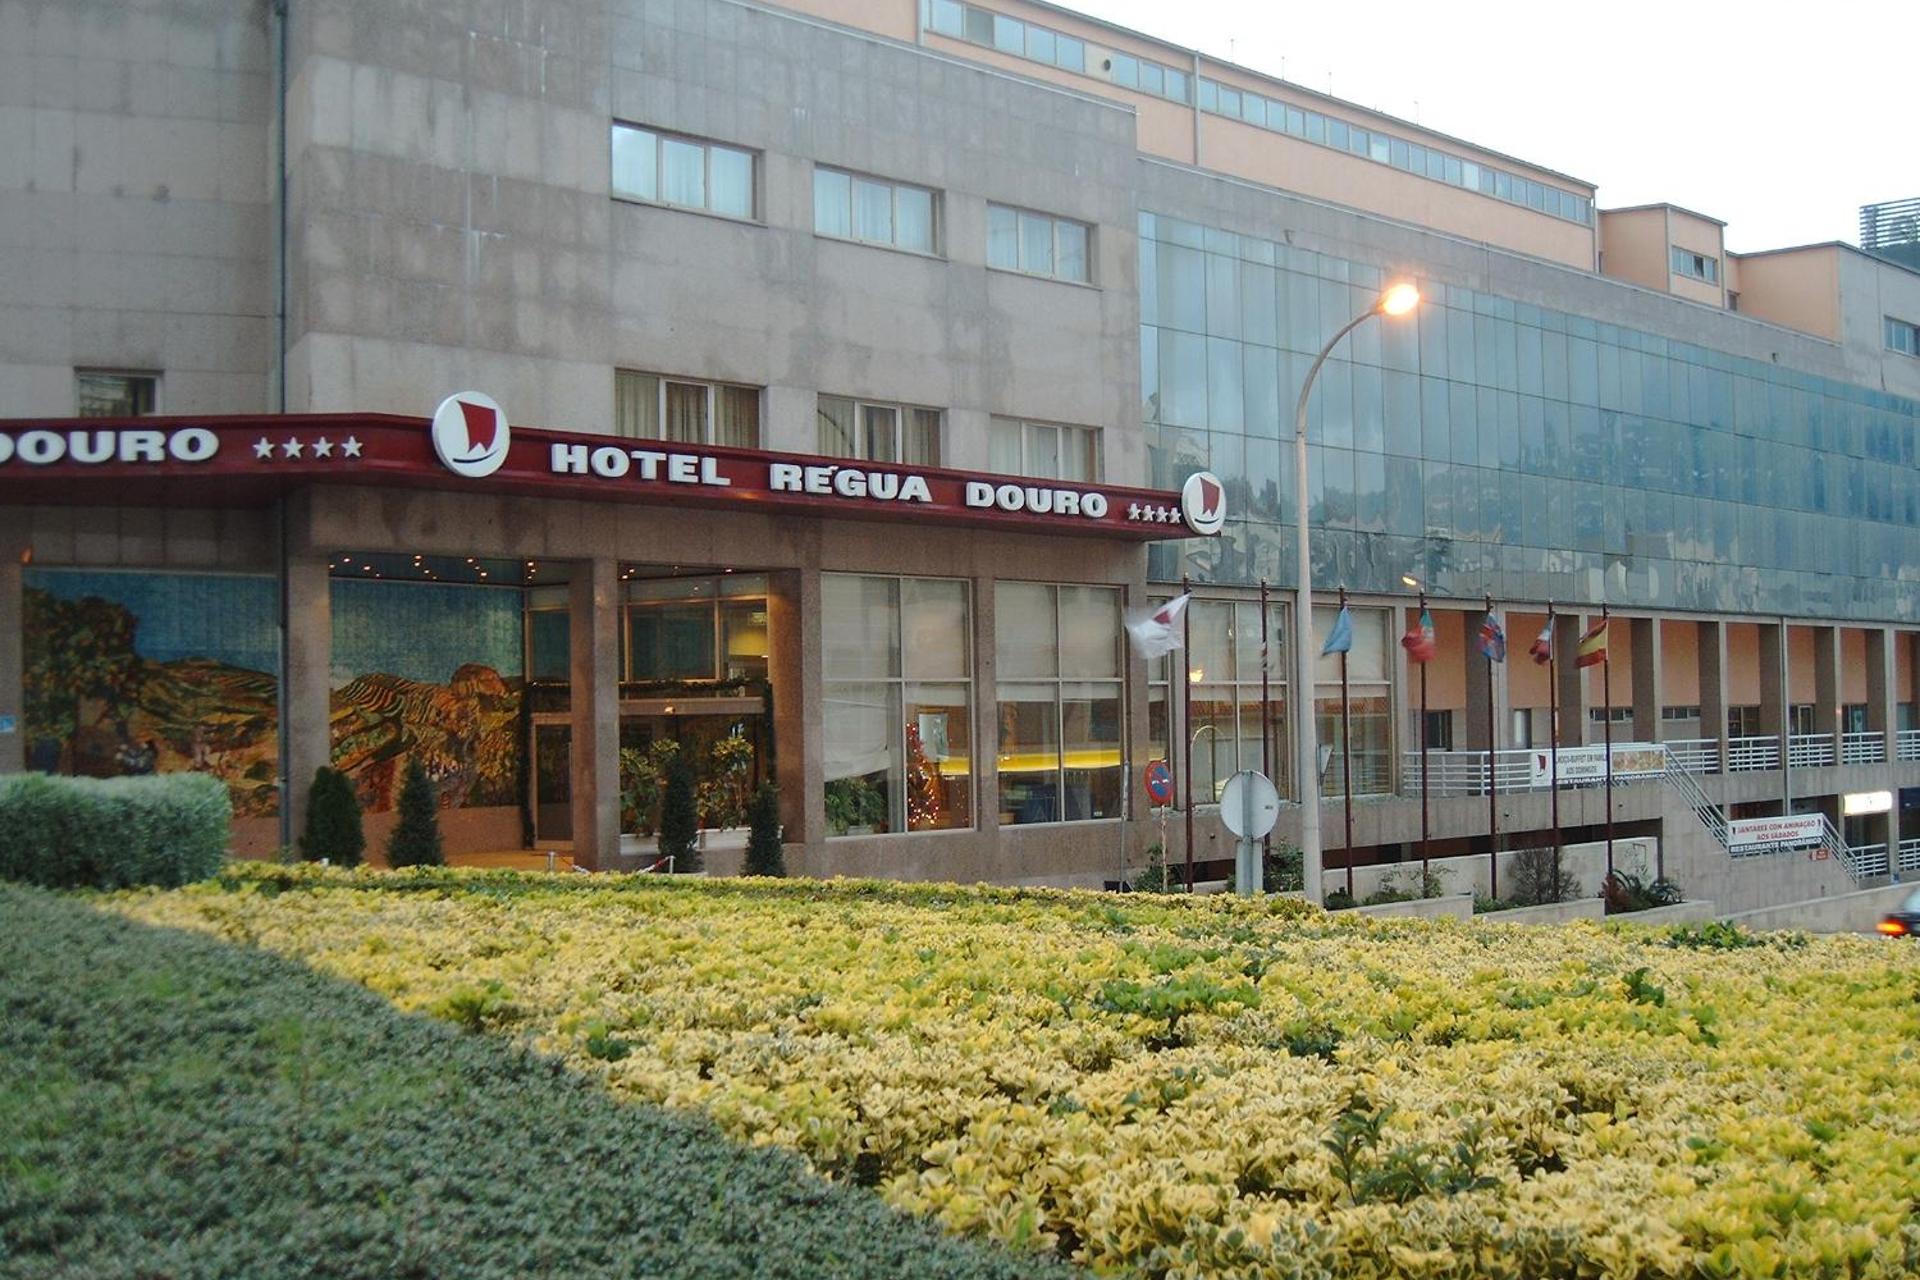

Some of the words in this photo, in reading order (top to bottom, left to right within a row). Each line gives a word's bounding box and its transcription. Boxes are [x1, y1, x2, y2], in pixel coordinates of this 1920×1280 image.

[550, 442, 732, 487] HOTEL
[769, 463, 934, 503] RÉGUA
[965, 480, 1109, 519] DOURO
[1730, 842, 1779, 853] RESTAURANTE
